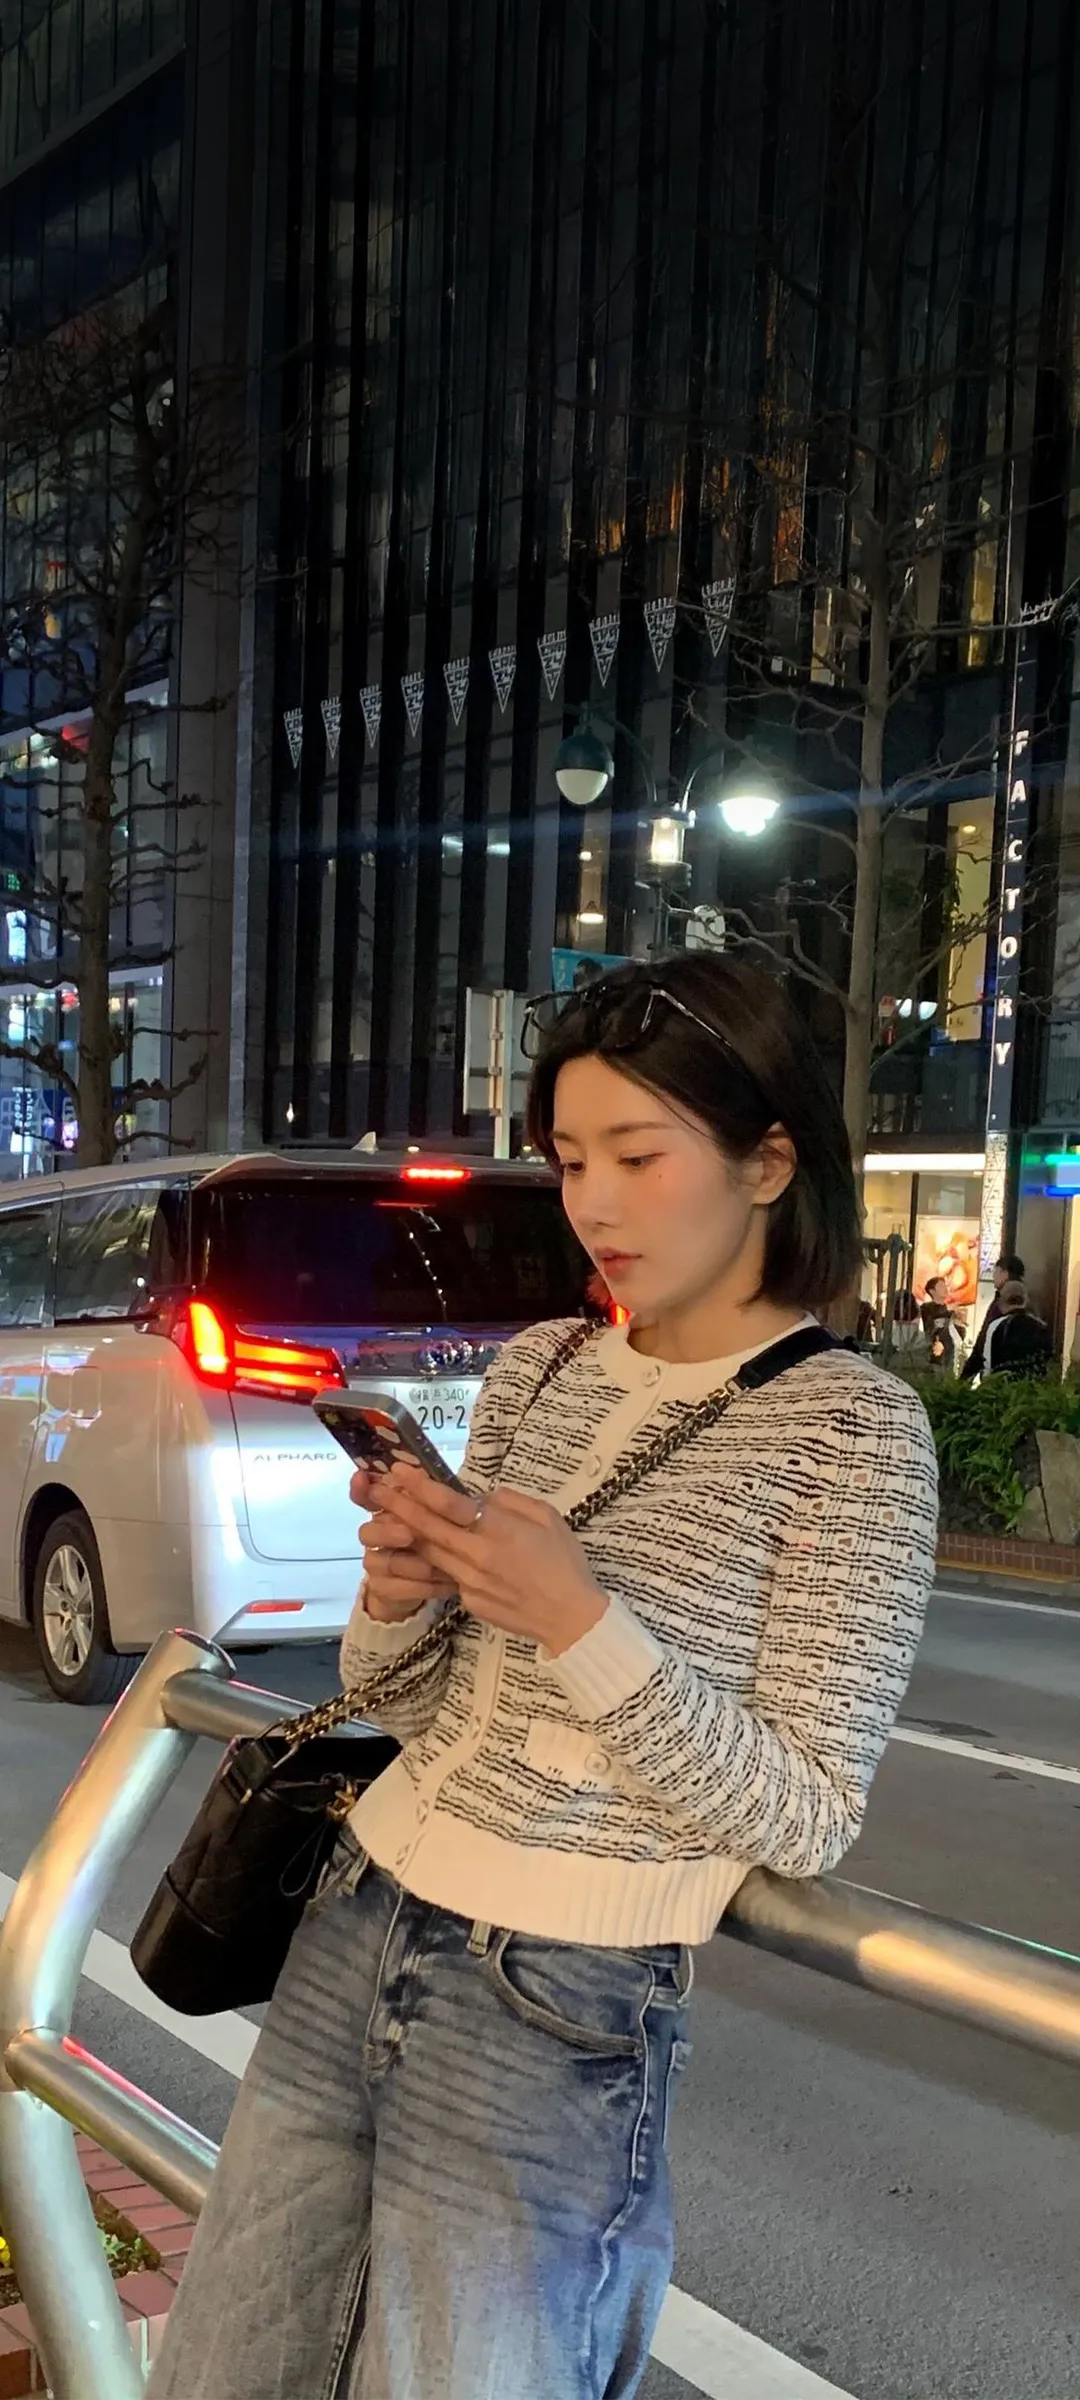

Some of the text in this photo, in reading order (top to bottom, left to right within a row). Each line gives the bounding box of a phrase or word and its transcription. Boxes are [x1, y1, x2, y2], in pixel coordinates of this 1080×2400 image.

[995, 730, 1030, 1066] FACTORY
[443, 1388, 464, 1401] 340
[418, 1405, 468, 1430] 20-2
[253, 1453, 338, 1463] ALPHARD
